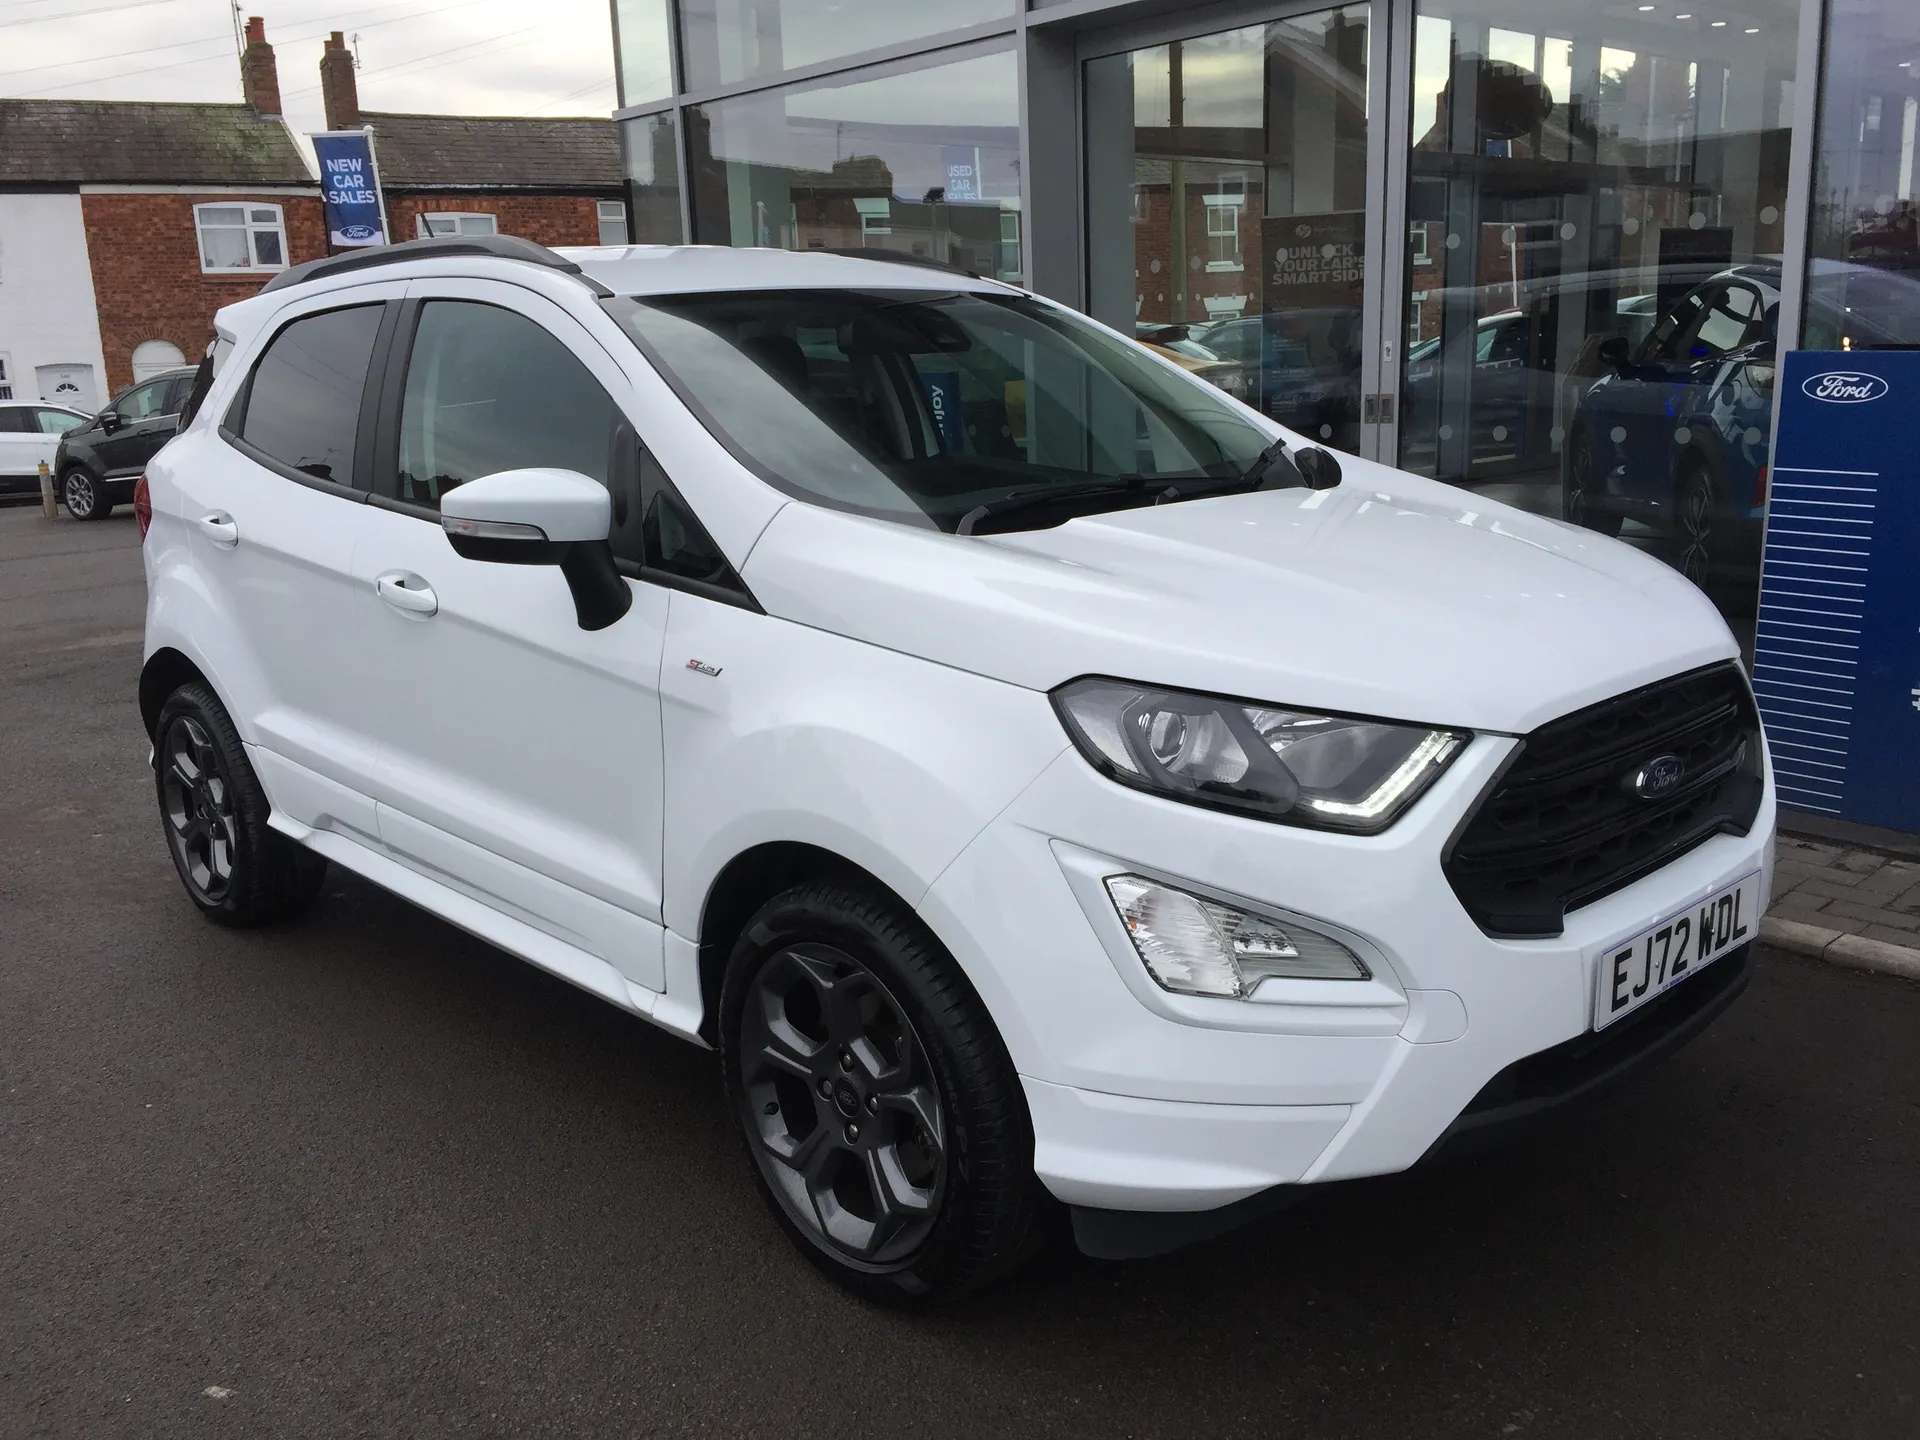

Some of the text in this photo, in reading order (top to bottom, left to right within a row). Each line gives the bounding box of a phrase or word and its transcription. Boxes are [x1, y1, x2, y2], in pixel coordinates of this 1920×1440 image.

[326, 158, 362, 172] NEW
[333, 174, 365, 188] CAR
[328, 190, 376, 204] SALES
[346, 227, 370, 238] Ford
[1288, 243, 1353, 260] UNLCK
[1272, 271, 1330, 285] SMART
[1816, 375, 1874, 398] Ford
[1611, 887, 1748, 1013] EJ72 WDL
